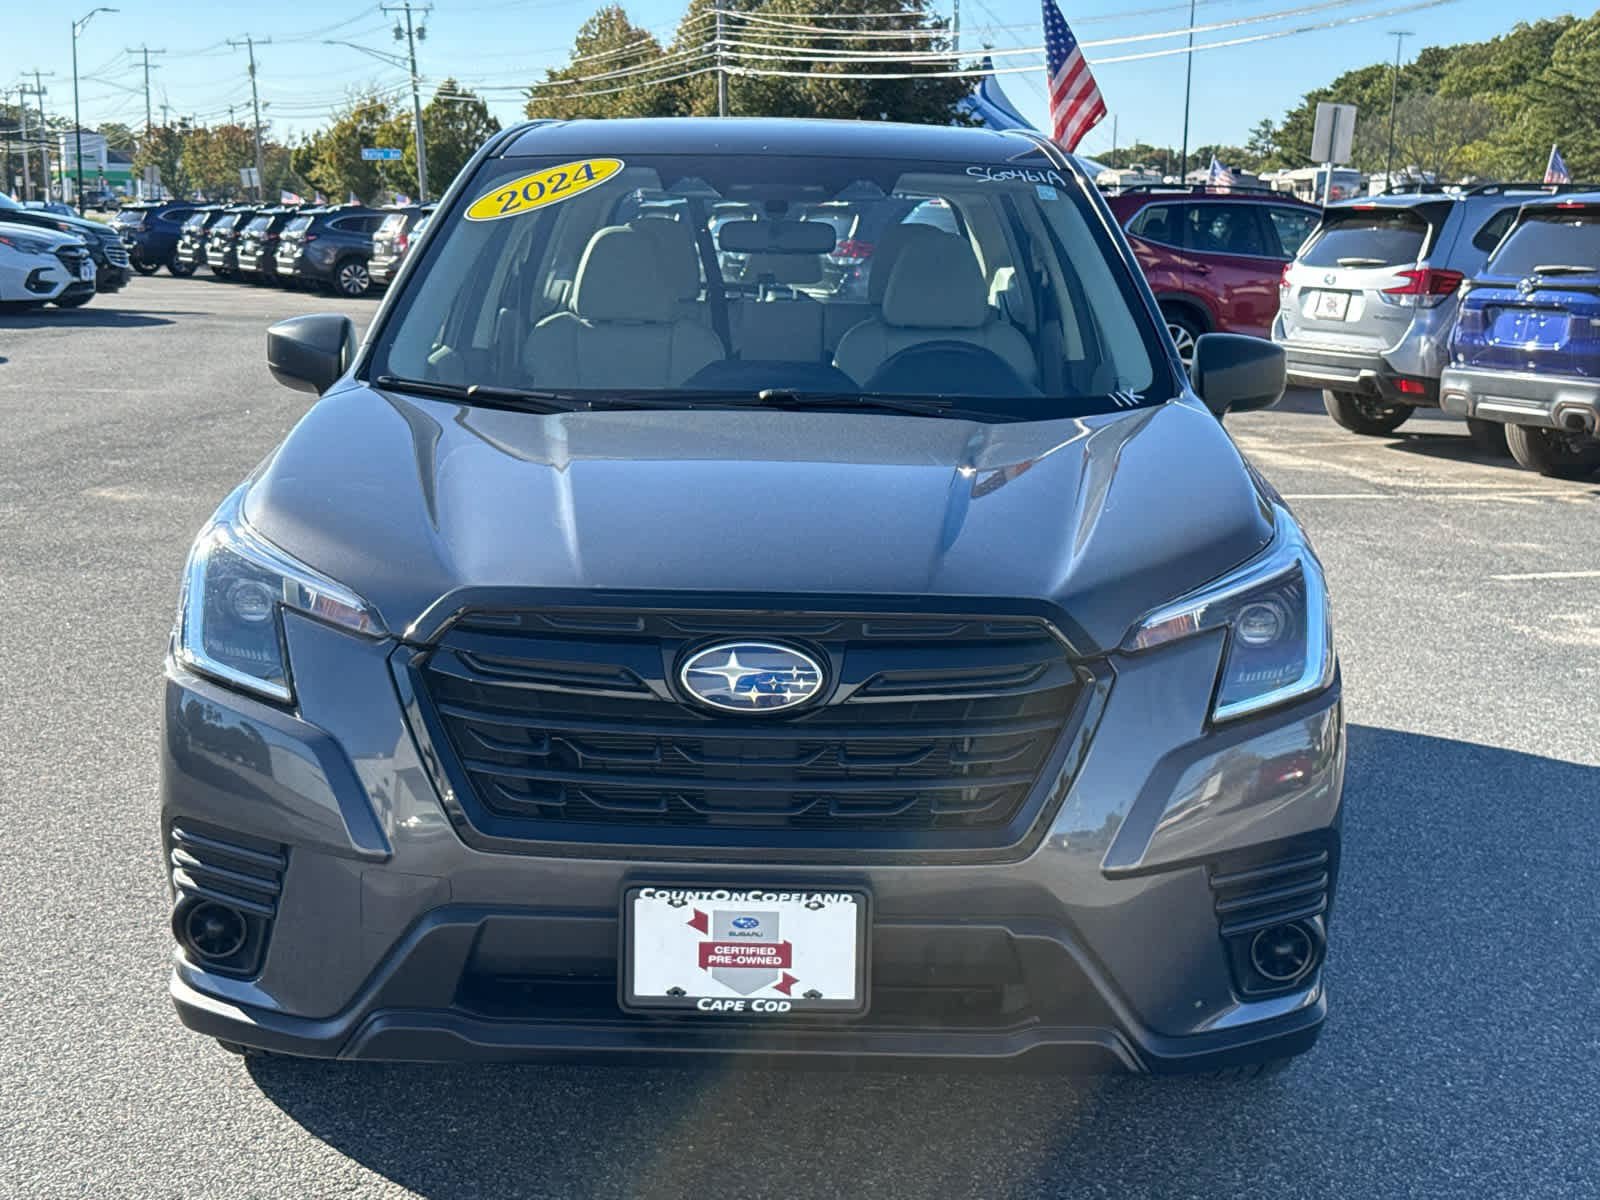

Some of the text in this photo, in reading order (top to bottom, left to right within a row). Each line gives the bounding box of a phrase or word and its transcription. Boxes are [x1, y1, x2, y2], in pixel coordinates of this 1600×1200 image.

[496, 163, 603, 213] 2024
[714, 946, 776, 956] CERTIFIED
[708, 955, 782, 965] PRE-OWNED
[697, 998, 792, 1013] CAPE COD
